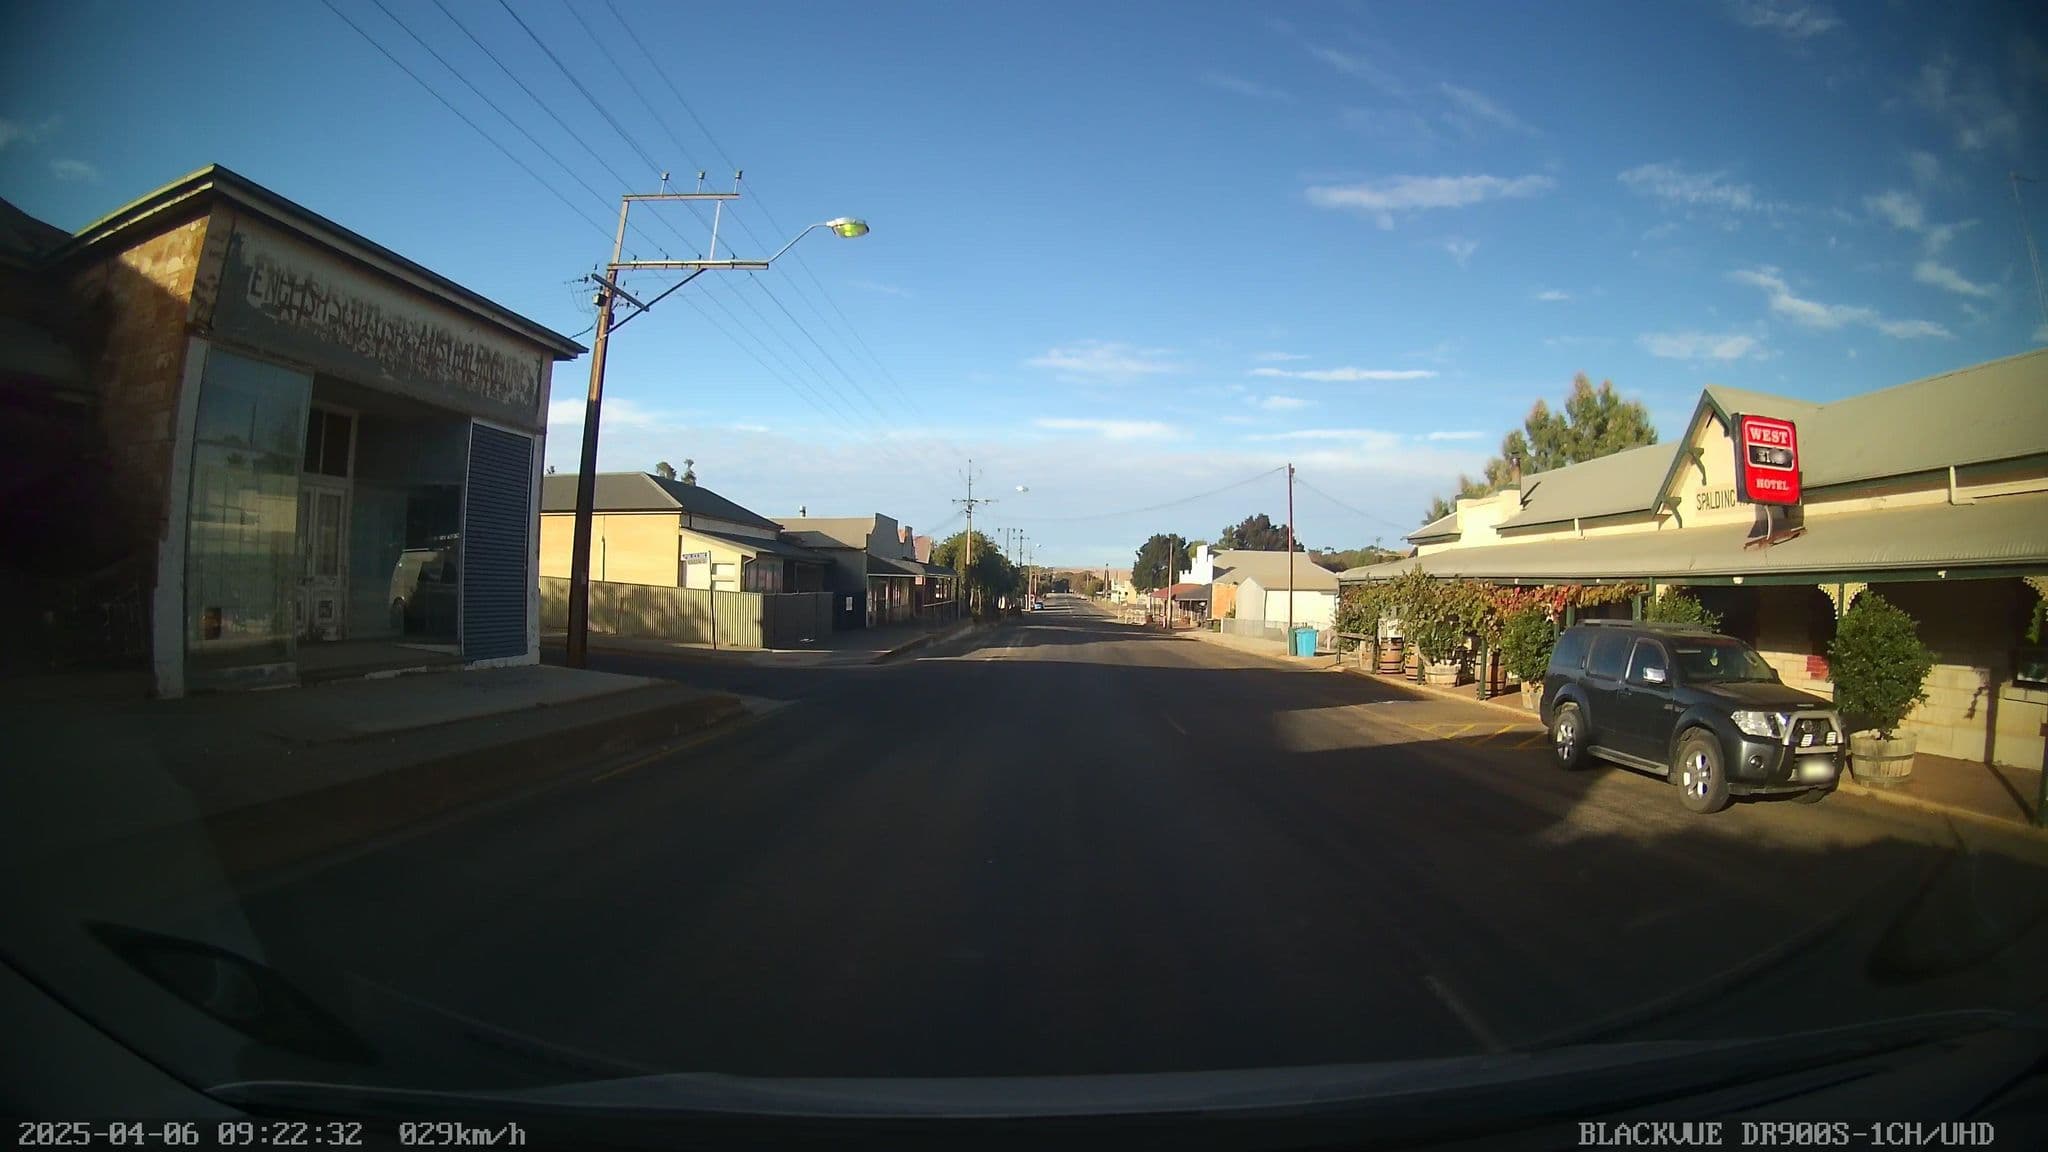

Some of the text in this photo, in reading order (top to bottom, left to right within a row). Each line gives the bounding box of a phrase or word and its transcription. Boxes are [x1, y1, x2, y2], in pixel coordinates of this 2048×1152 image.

[1750, 427, 1788, 444] WEST
[1755, 478, 1790, 491] HOTEL
[1696, 489, 1736, 511] SPALDING
